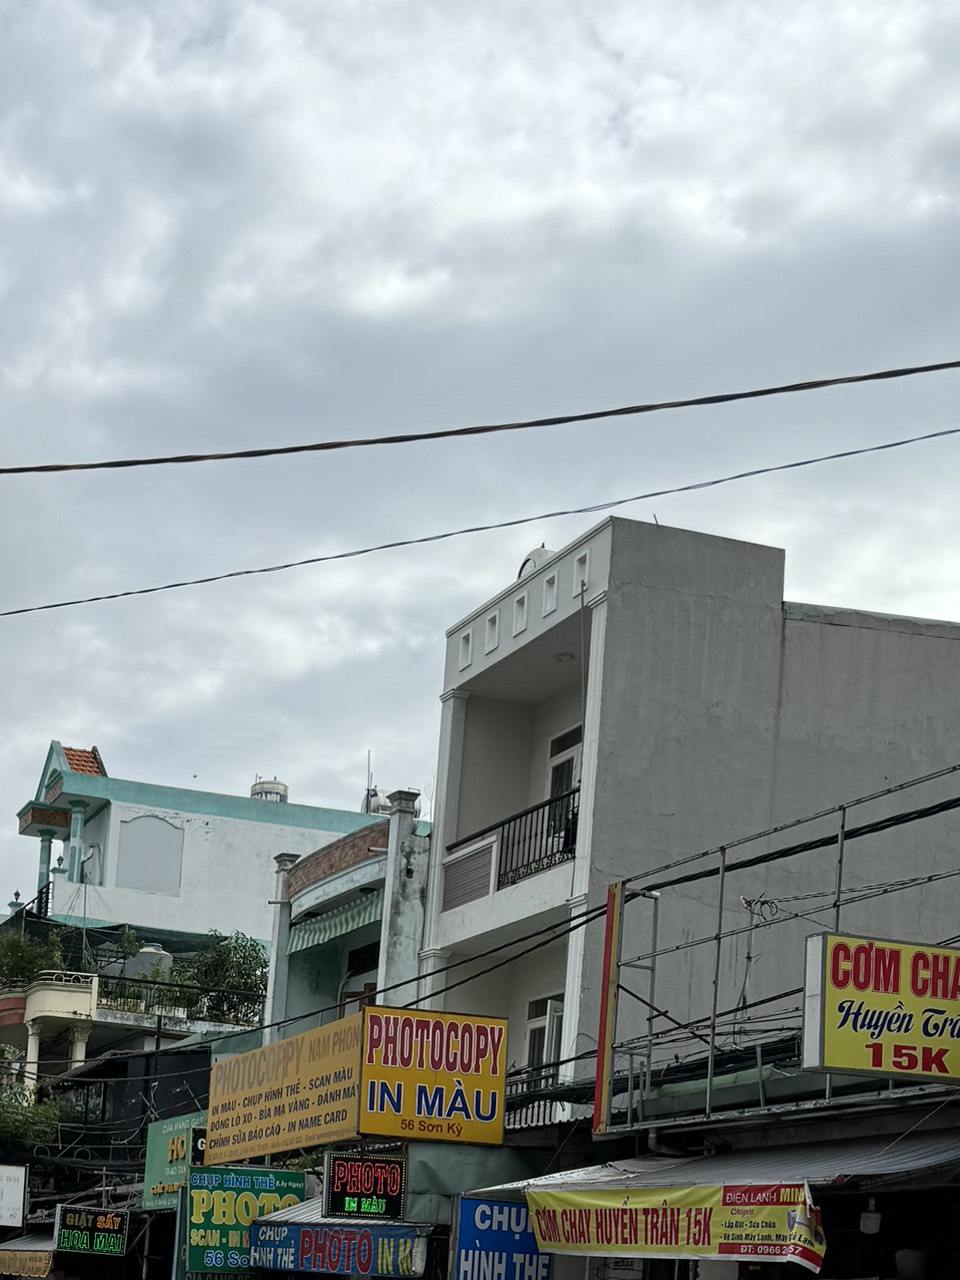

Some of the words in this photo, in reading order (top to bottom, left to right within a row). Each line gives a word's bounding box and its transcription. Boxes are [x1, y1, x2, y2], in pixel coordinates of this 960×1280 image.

[831, 941, 902, 995] CƠM
[910, 951, 960, 1001] CHA
[837, 1001, 914, 1039] Huyền
[308, 1039, 330, 1063] NAM
[332, 1023, 360, 1055] PHON
[366, 1013, 504, 1076] PHOTOCOPY
[865, 1042, 951, 1074] 15K
[212, 1104, 219, 1116] IN
[221, 1101, 237, 1114] MÀU
[242, 1093, 263, 1109] CHỤP
[264, 1087, 283, 1102] HÌNH
[286, 1078, 301, 1097] THẺ
[309, 1075, 331, 1091] SCAN
[333, 1066, 353, 1084] MÀU
[367, 1079, 404, 1115] IN
[415, 1077, 499, 1123] MÀU
[211, 1117, 230, 1132] ĐÓNG
[231, 1112, 241, 1127] LÒ
[242, 1112, 253, 1125] XO
[259, 1105, 271, 1121] BÌA
[274, 1104, 286, 1118] MẠ
[288, 1097, 310, 1113] VÀNG
[317, 1090, 341, 1107] ĐÁNH
[400, 1119, 415, 1131] 56
[418, 1119, 443, 1133] Sơn
[209, 1133, 230, 1149] CHỈNH
[232, 1129, 246, 1145] SỬA
[248, 1126, 263, 1141] BÁO
[265, 1122, 281, 1137] CÁO
[288, 1121, 296, 1133] IN
[298, 1114, 322, 1131] NAME
[324, 1108, 348, 1125] CARD
[167, 1136, 186, 1163] HO
[190, 1173, 221, 1189] CHỤP
[223, 1172, 251, 1188] HÌNH
[333, 1160, 401, 1196] PHOTO
[344, 1196, 359, 1212] IN
[360, 1196, 387, 1214] MÀU
[726, 1192, 749, 1204] ĐIỆN
[751, 1192, 777, 1205] LẠNH
[780, 1187, 805, 1203] MIN
[65, 1211, 93, 1229] GIẶT
[96, 1211, 122, 1230] SẤY
[535, 1205, 561, 1243] CƠM
[561, 1207, 591, 1244] CHAY
[642, 1199, 681, 1246] TRÂN
[685, 1207, 713, 1247] 15K
[60, 1229, 91, 1249] HOA
[93, 1232, 125, 1252] MAI
[190, 1229, 219, 1247] SCAN
[228, 1230, 240, 1248] IN
[250, 1241, 274, 1267] HÌNH
[276, 1240, 295, 1269] THẺ
[258, 1226, 288, 1246] CHỤP
[299, 1228, 372, 1275] PHOTO
[377, 1237, 394, 1275] IN
[740, 1246, 755, 1254] ĐT:
[757, 1245, 781, 1254] 0966
[204, 1250, 224, 1267] 56
